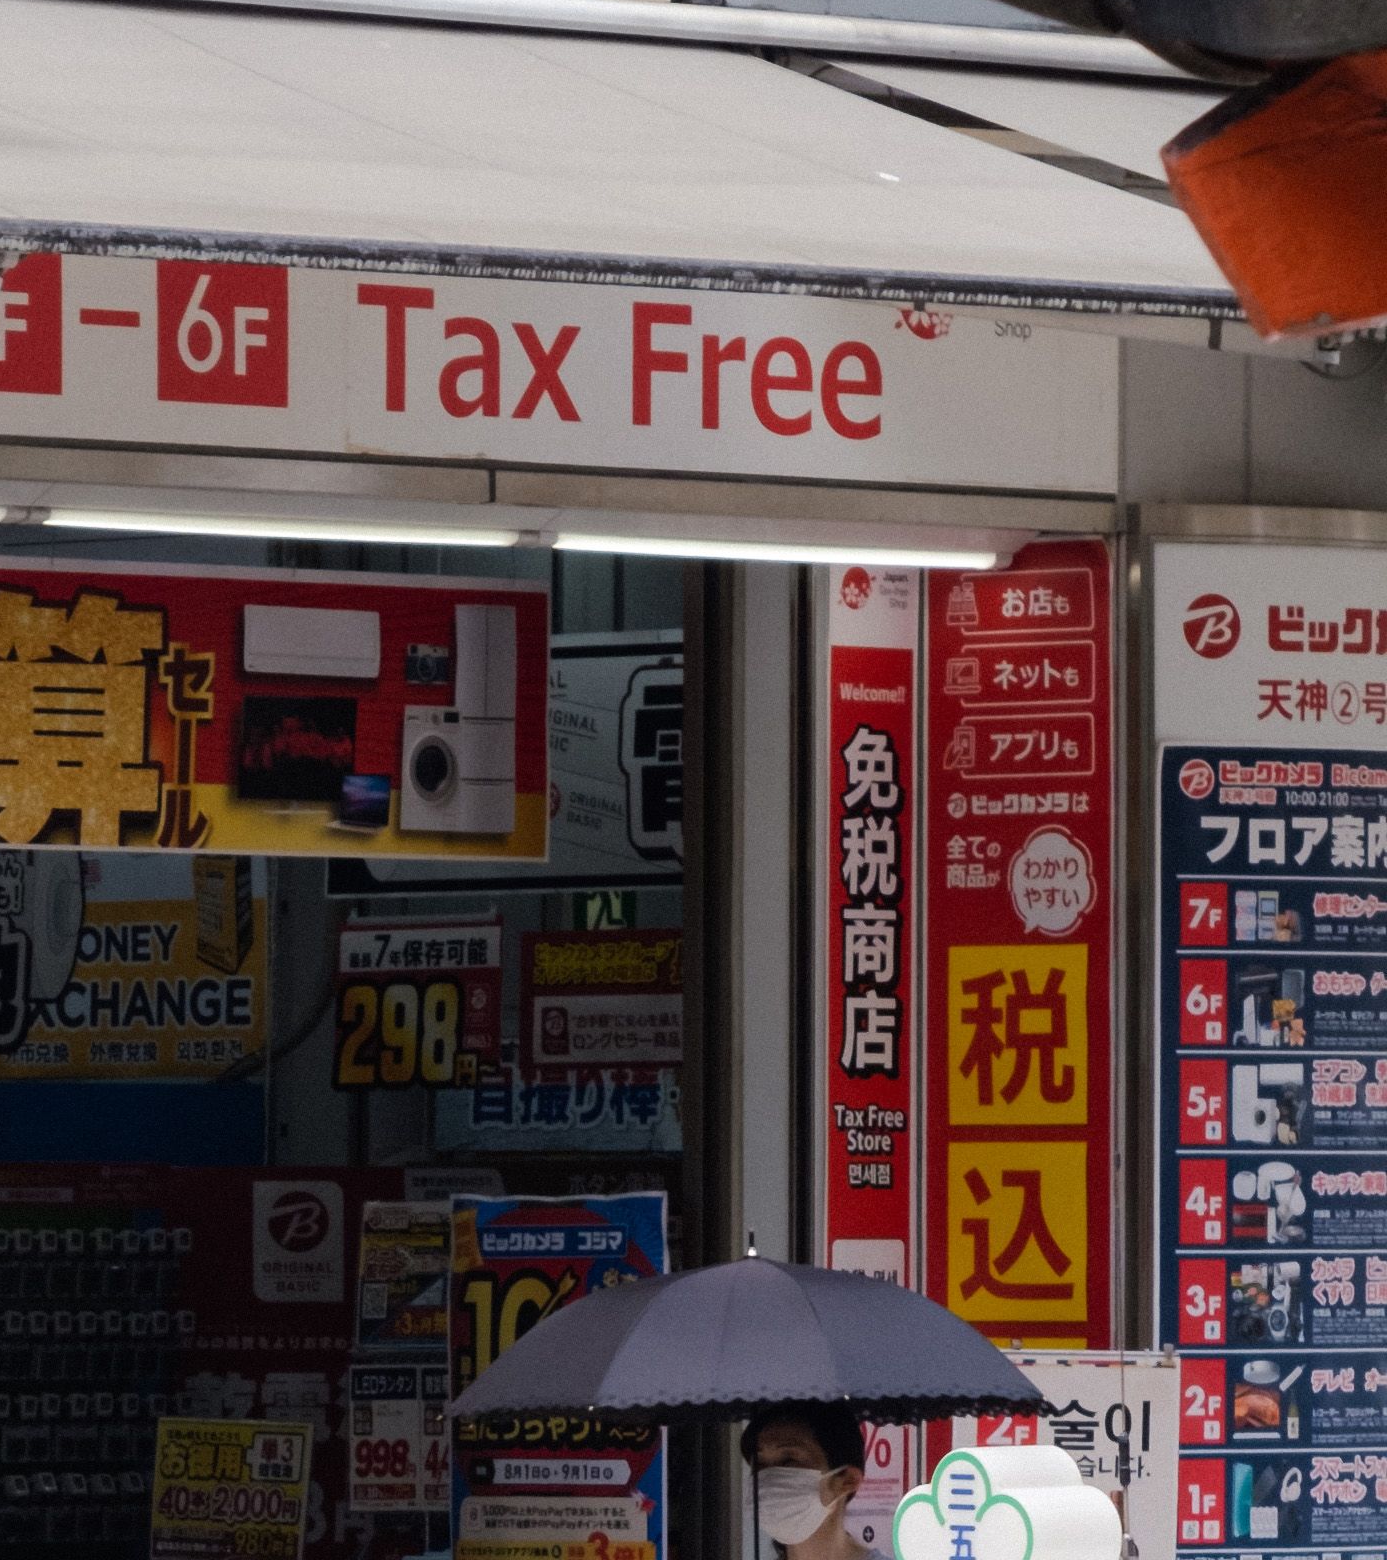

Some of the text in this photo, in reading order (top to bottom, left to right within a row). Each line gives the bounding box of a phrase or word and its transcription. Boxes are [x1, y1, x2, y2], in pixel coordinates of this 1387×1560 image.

[358, 284, 885, 439] Tax Free
[1001, 588, 1070, 618] お店も
[1267, 604, 1387, 655] ビック
[992, 658, 1080, 690] ネットも
[156, 643, 215, 849] セール
[988, 730, 1079, 762] アプリも
[1218, 760, 1324, 788] ビックカメラ
[970, 792, 1090, 816] ビックカメラは
[945, 835, 1002, 860] 全ての
[945, 863, 1001, 890] 商品が
[1022, 856, 1080, 880] わかり
[840, 727, 900, 1071] 免税商店
[1022, 887, 1081, 908] やすい
[1188, 899, 1223, 929] 7F
[76, 924, 179, 963] ONEY
[1185, 984, 1223, 1016] 6F
[834, 1105, 905, 1128] Tax Free
[1185, 1086, 1223, 1117] 5F
[846, 1129, 893, 1152] Store
[847, 1163, 891, 1186] 면세점
[1184, 1186, 1223, 1216] 4F
[1184, 1284, 1222, 1317] 3F
[1184, 1385, 1222, 1416] 2F
[1187, 1484, 1218, 1515] 1F
